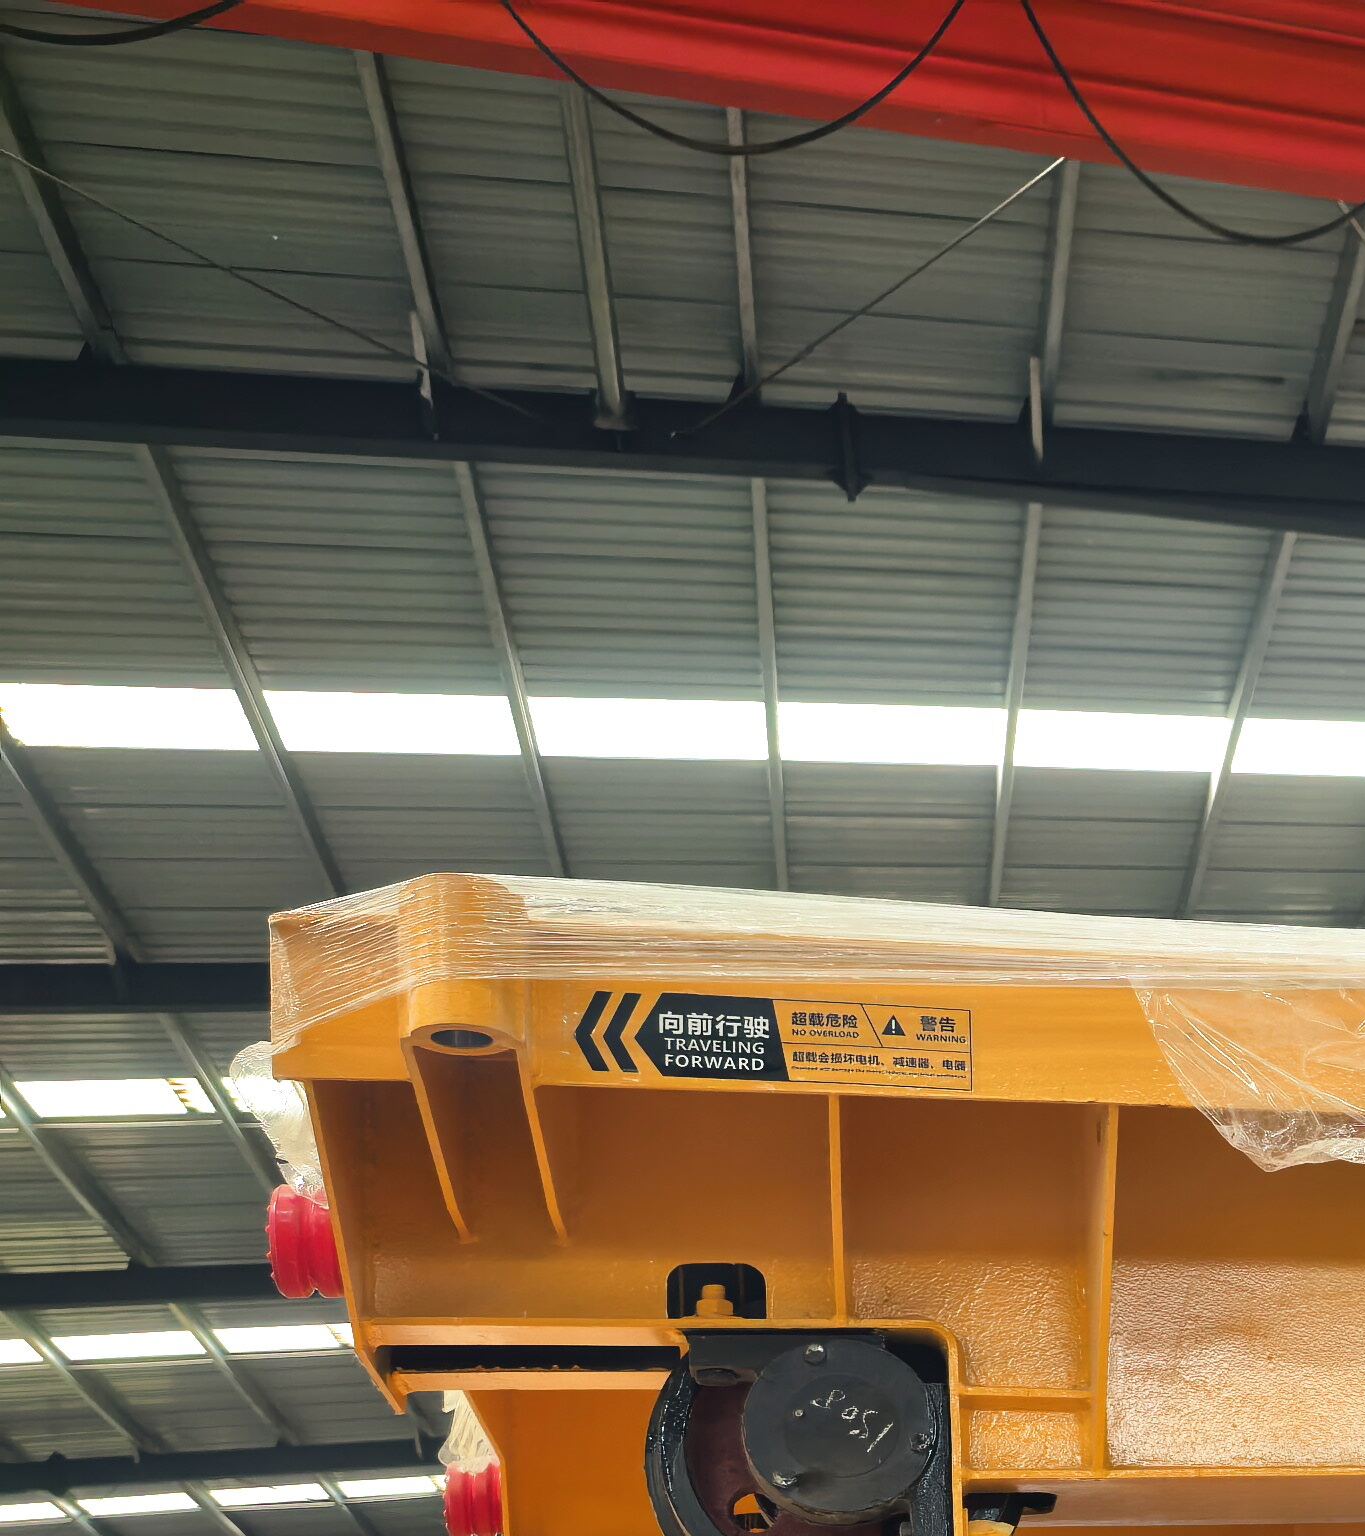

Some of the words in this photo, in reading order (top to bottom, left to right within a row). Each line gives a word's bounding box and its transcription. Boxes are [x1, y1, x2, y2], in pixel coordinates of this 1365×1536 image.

[658, 1011, 770, 1039] 向前行驶
[791, 1011, 858, 1029] 超载危险
[920, 1015, 956, 1033] 警告
[792, 1028, 807, 1036] NO
[809, 1029, 860, 1039] OVERLOAD
[916, 1033, 967, 1044] WARNING
[664, 1037, 765, 1055] TRAVELING
[665, 1054, 765, 1071] FORWARD
